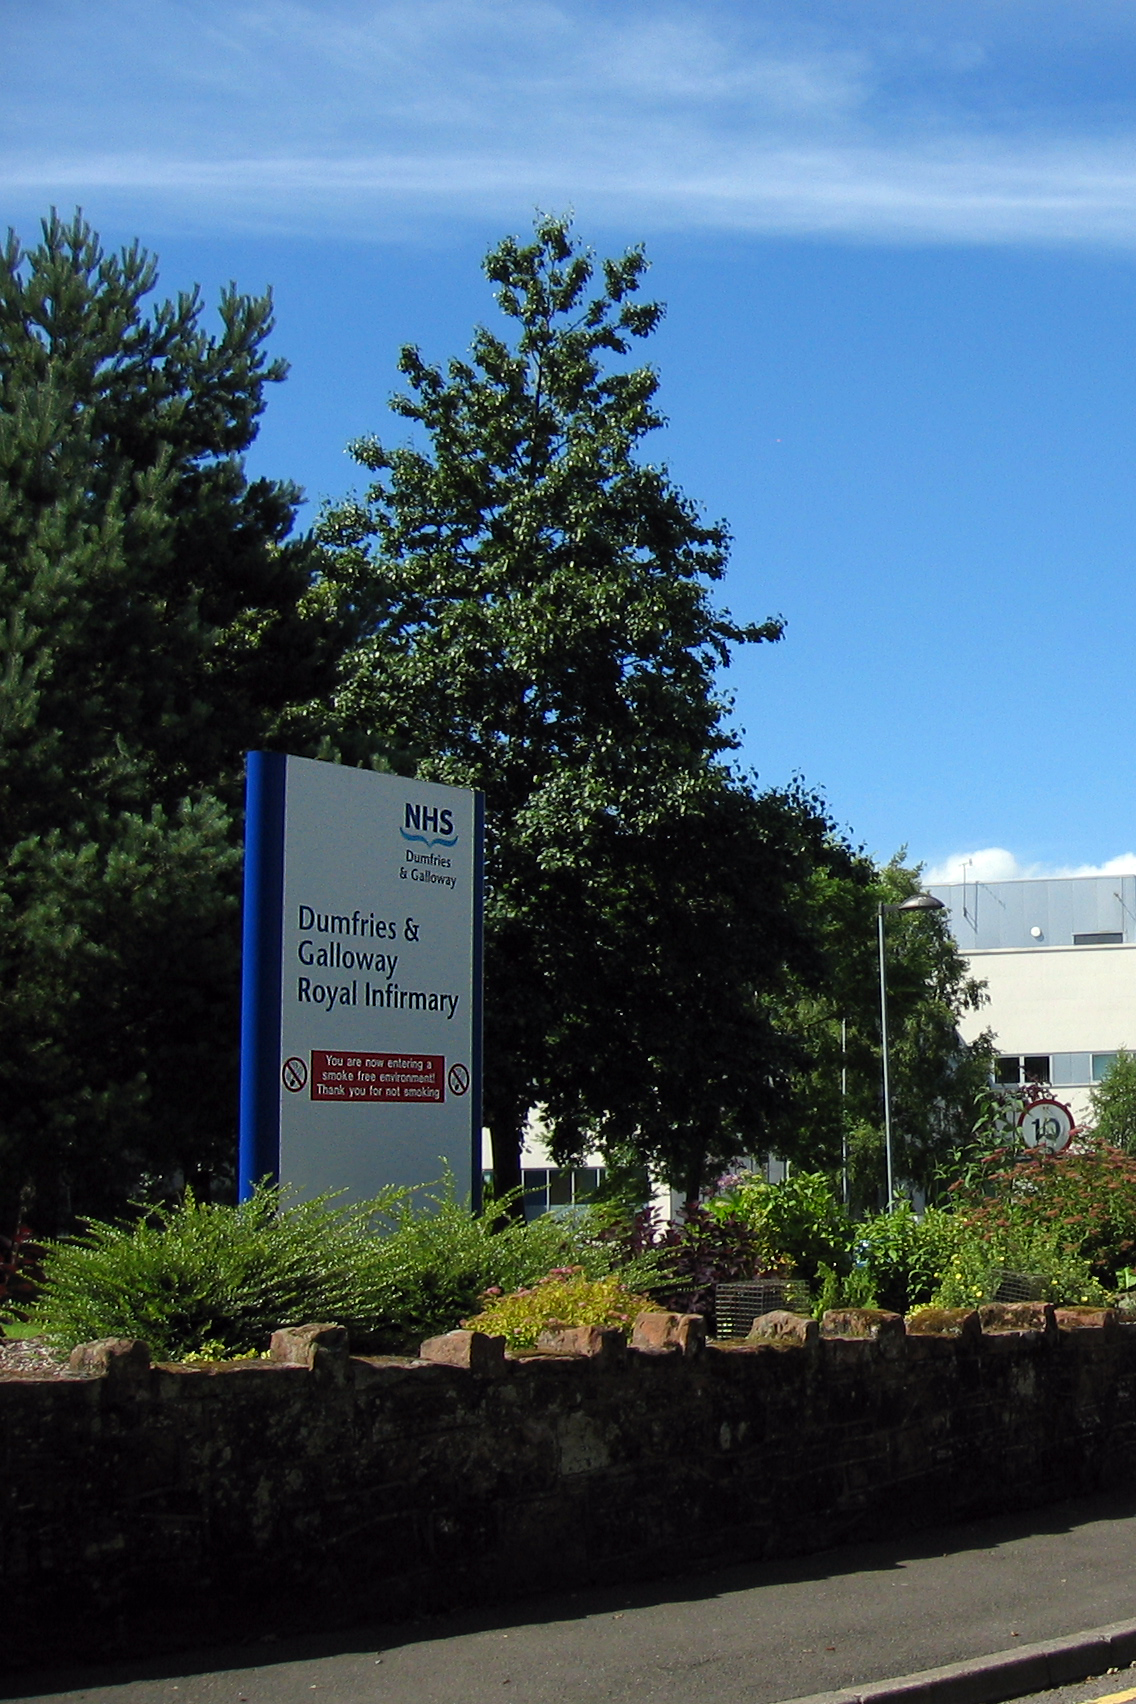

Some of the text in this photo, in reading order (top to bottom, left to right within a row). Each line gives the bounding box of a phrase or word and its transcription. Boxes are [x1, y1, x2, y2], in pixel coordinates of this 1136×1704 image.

[405, 803, 453, 835] NHS
[406, 849, 452, 868] Dumfries
[399, 866, 457, 890] & Galloway
[298, 904, 420, 943] Dumfries &
[298, 939, 399, 981] Galloway
[298, 976, 459, 1020] Royal Infirmary
[326, 1055, 432, 1071] You are now entering a
[322, 1069, 435, 1084] smoke free environment!
[316, 1083, 440, 1100] Thank you for not smoking
[1031, 1118, 1061, 1141] 10
